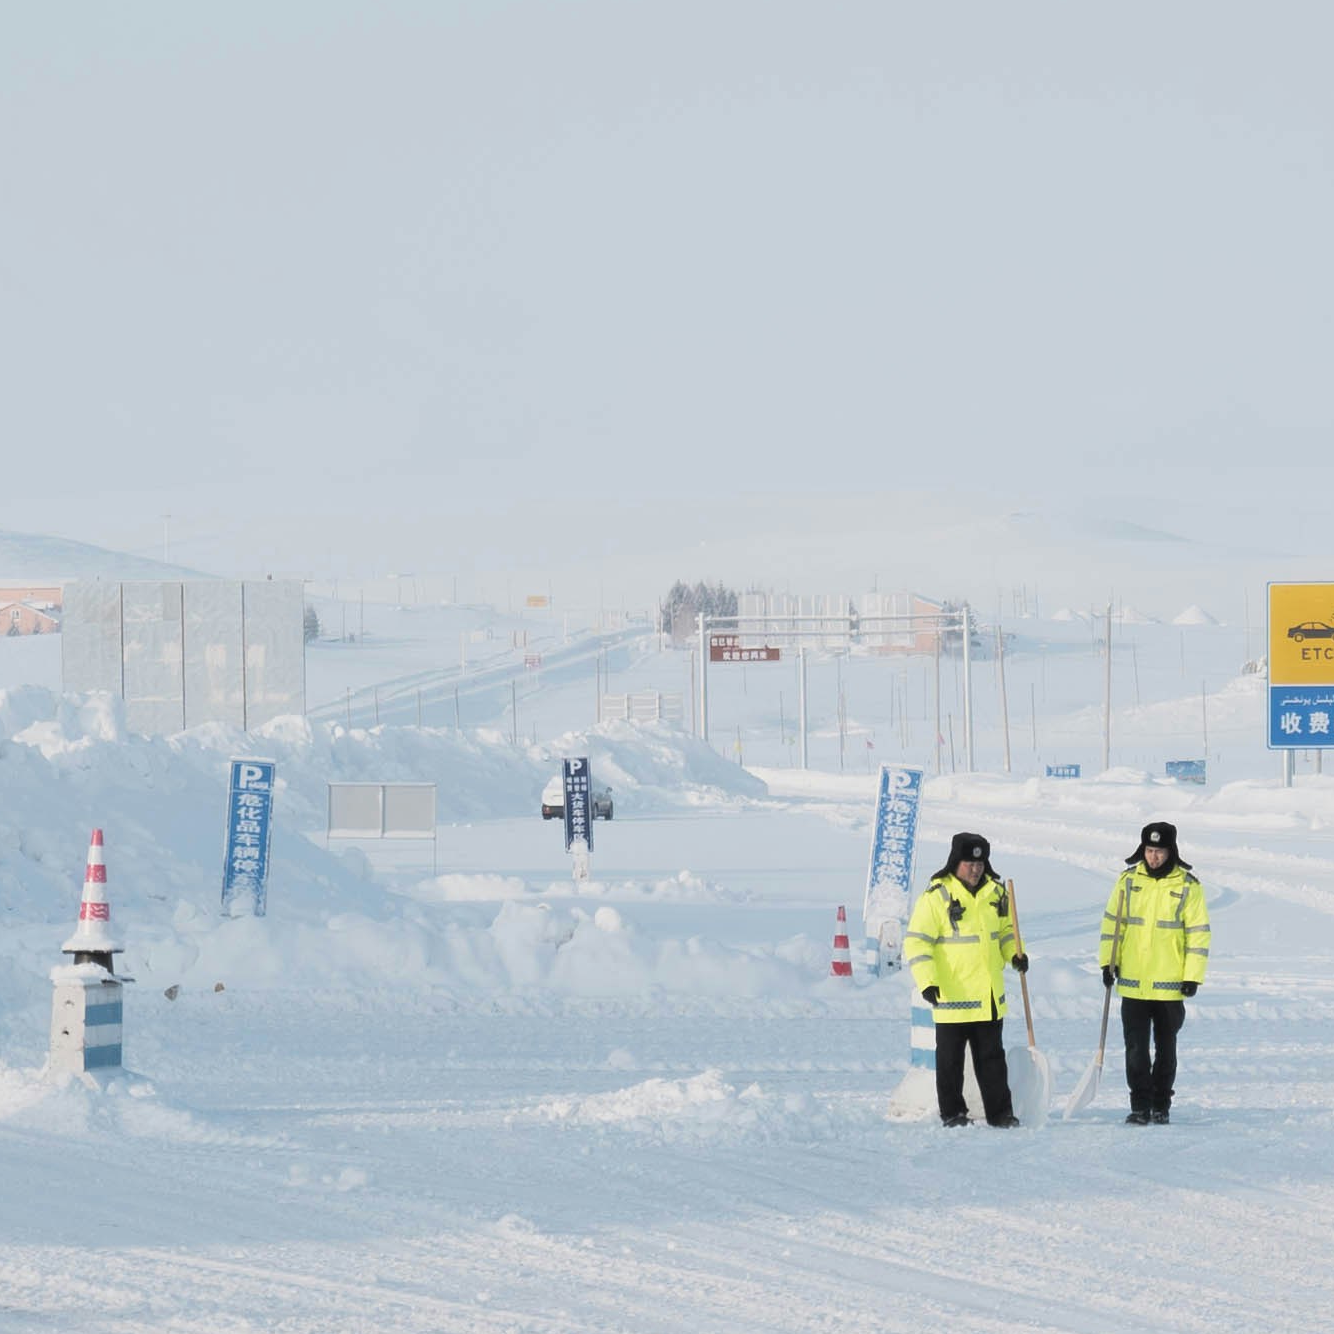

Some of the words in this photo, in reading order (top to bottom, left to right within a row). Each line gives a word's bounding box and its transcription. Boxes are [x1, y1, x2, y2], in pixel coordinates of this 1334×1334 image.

[1301, 648, 1334, 660] ETC
[239, 764, 263, 789] P
[570, 759, 582, 775] P
[888, 770, 912, 796] P
